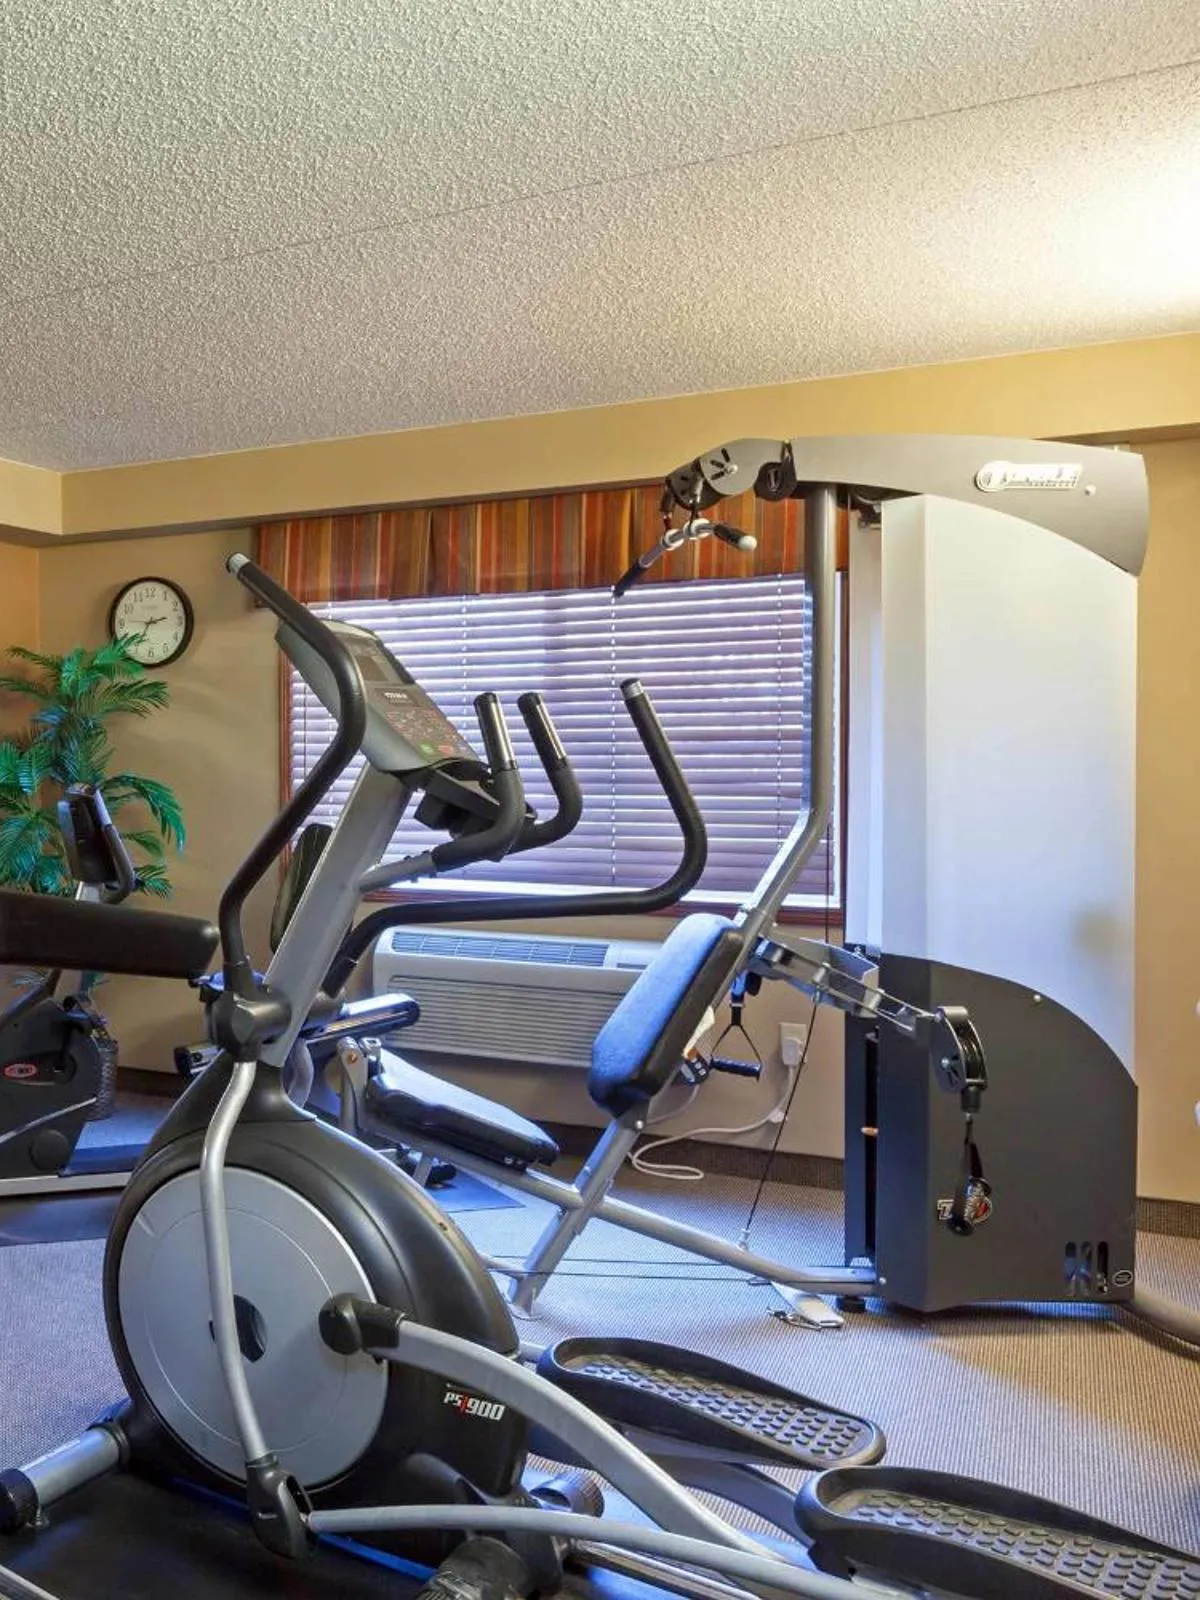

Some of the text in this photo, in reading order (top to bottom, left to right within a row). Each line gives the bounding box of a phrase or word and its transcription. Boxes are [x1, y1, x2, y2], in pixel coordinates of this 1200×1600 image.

[133, 591, 144, 603] 11
[144, 587, 156, 598] 12
[123, 603, 134, 615] 10
[172, 600, 179, 612] 2
[147, 647, 155, 658] 6
[162, 642, 169, 654] 5
